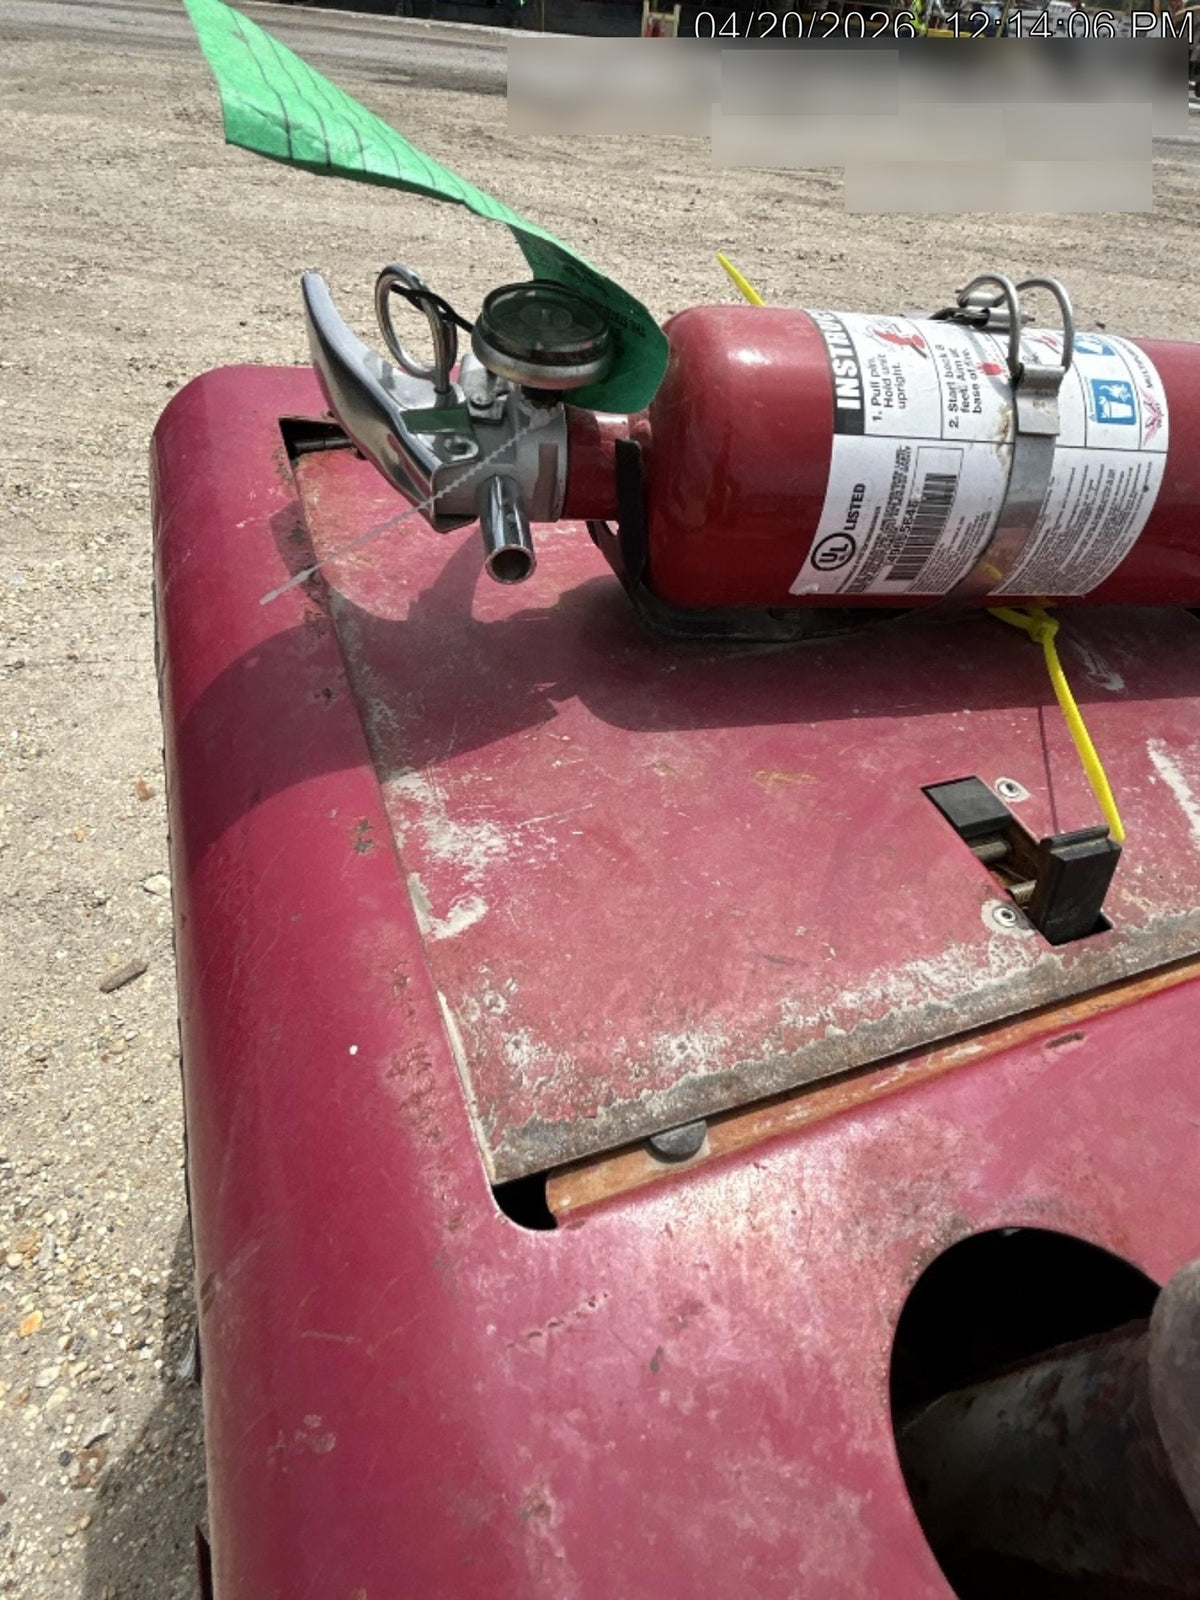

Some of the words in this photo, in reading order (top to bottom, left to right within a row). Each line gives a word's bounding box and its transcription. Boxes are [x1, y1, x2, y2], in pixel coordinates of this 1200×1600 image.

[878, 353, 891, 375] unit
[940, 353, 955, 378] back
[954, 360, 967, 381] Aim
[967, 368, 979, 381] of
[870, 381, 882, 406] Pull
[881, 378, 894, 408] Hold
[946, 381, 959, 413] Start
[972, 383, 983, 414] base
[872, 410, 883, 422] 1.
[948, 416, 960, 429] 2.
[844, 482, 866, 531] LISTED
